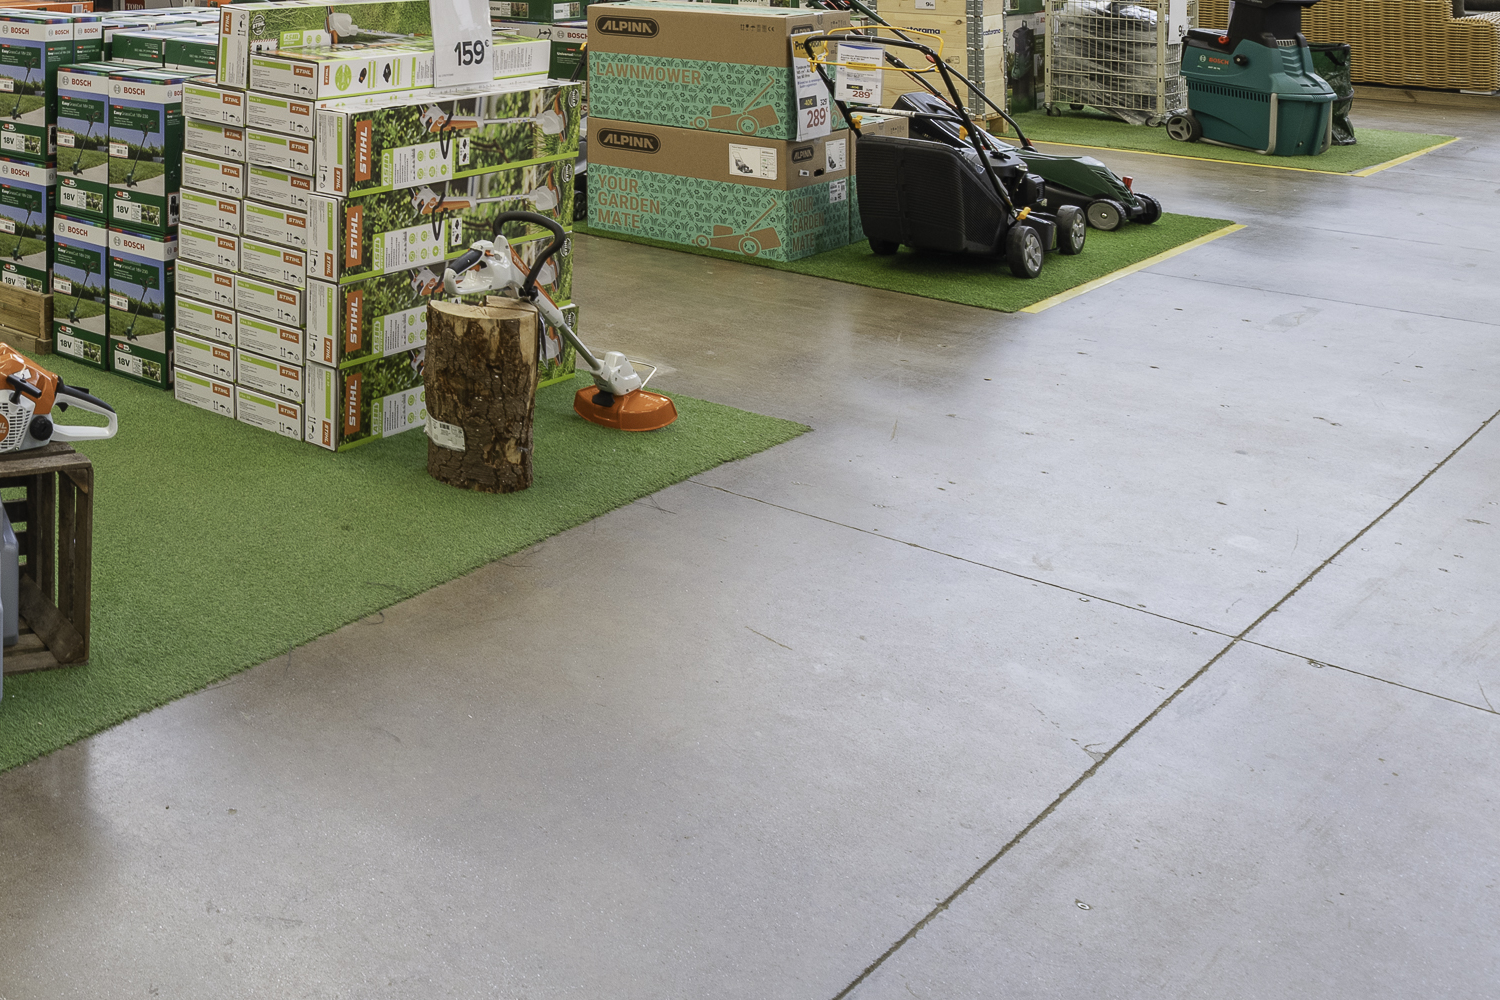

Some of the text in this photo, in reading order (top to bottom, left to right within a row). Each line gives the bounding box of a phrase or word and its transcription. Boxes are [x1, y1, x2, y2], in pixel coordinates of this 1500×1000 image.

[596, 61, 702, 86] LAWNMOWER
[359, 126, 368, 174] STIHL
[599, 174, 639, 193] YOUR
[598, 190, 661, 215] GARDEN
[599, 208, 641, 230] MATE
[350, 211, 359, 260] STIHL
